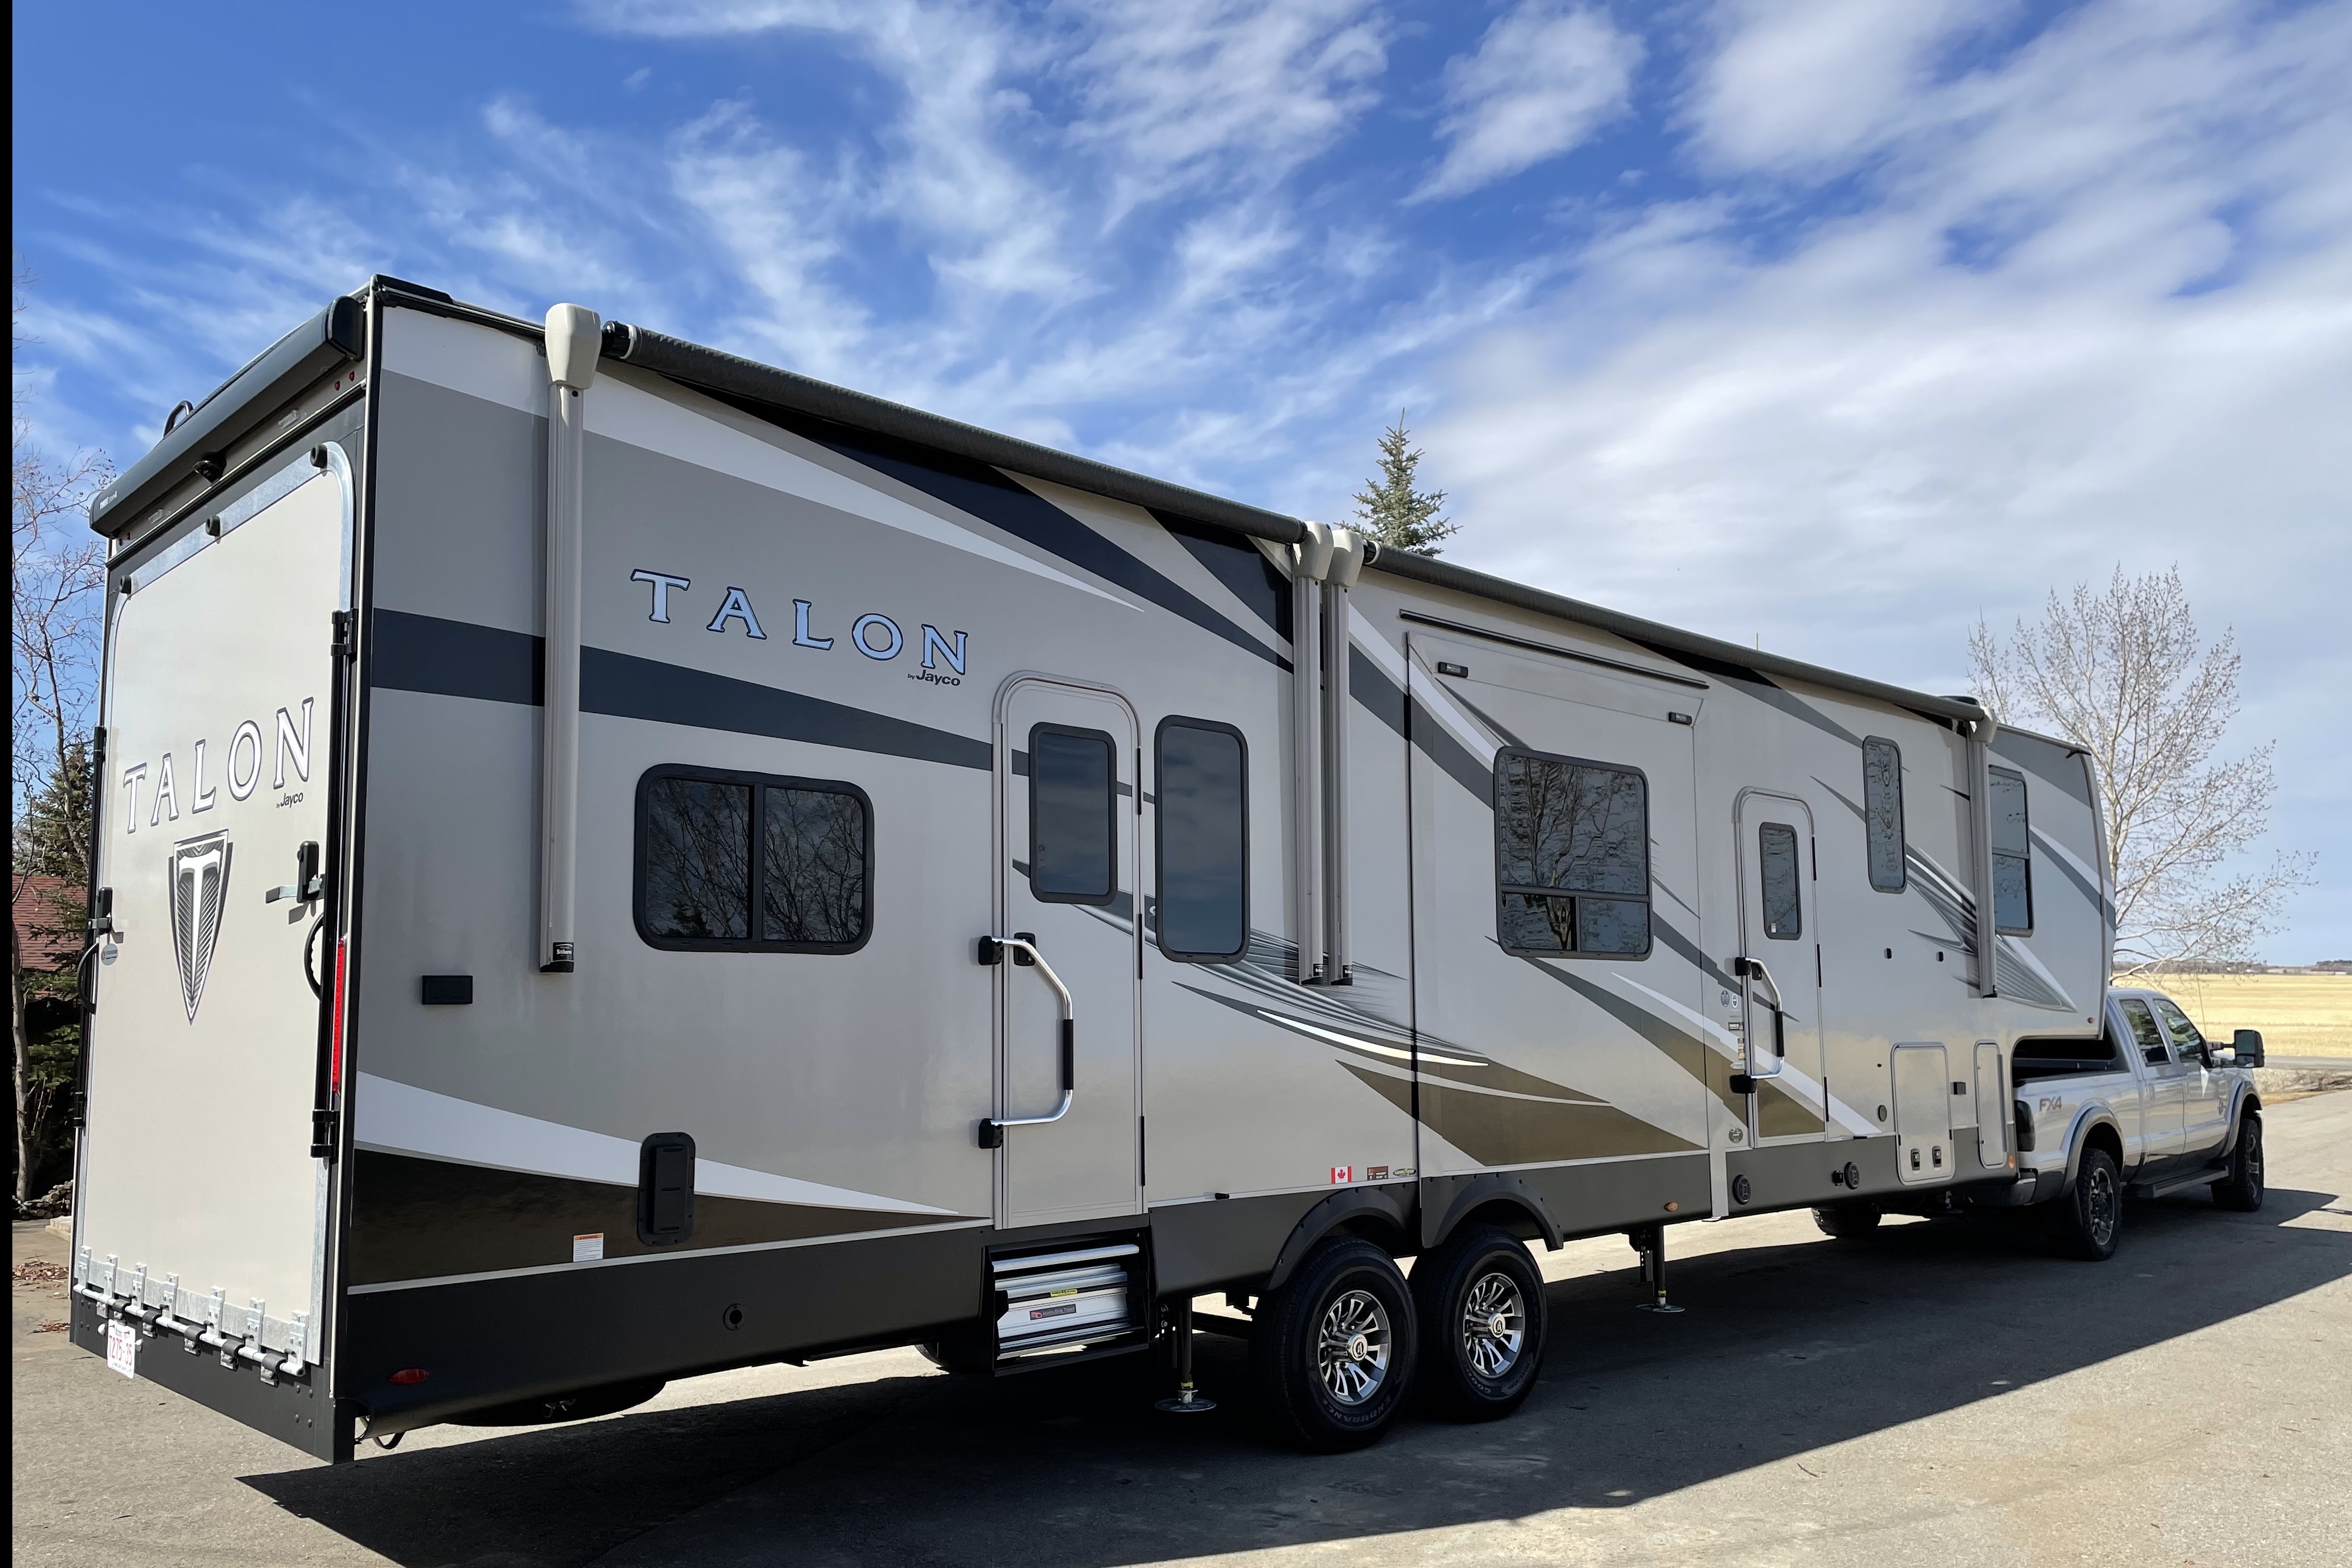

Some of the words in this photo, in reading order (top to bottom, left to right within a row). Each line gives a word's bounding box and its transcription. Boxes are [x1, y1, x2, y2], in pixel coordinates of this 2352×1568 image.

[630, 569, 967, 675] TALON
[916, 670, 961, 686] Jayco
[123, 696, 313, 834] TALON
[280, 792, 303, 808] Jayco
[2039, 1096, 2062, 1112] FX4
